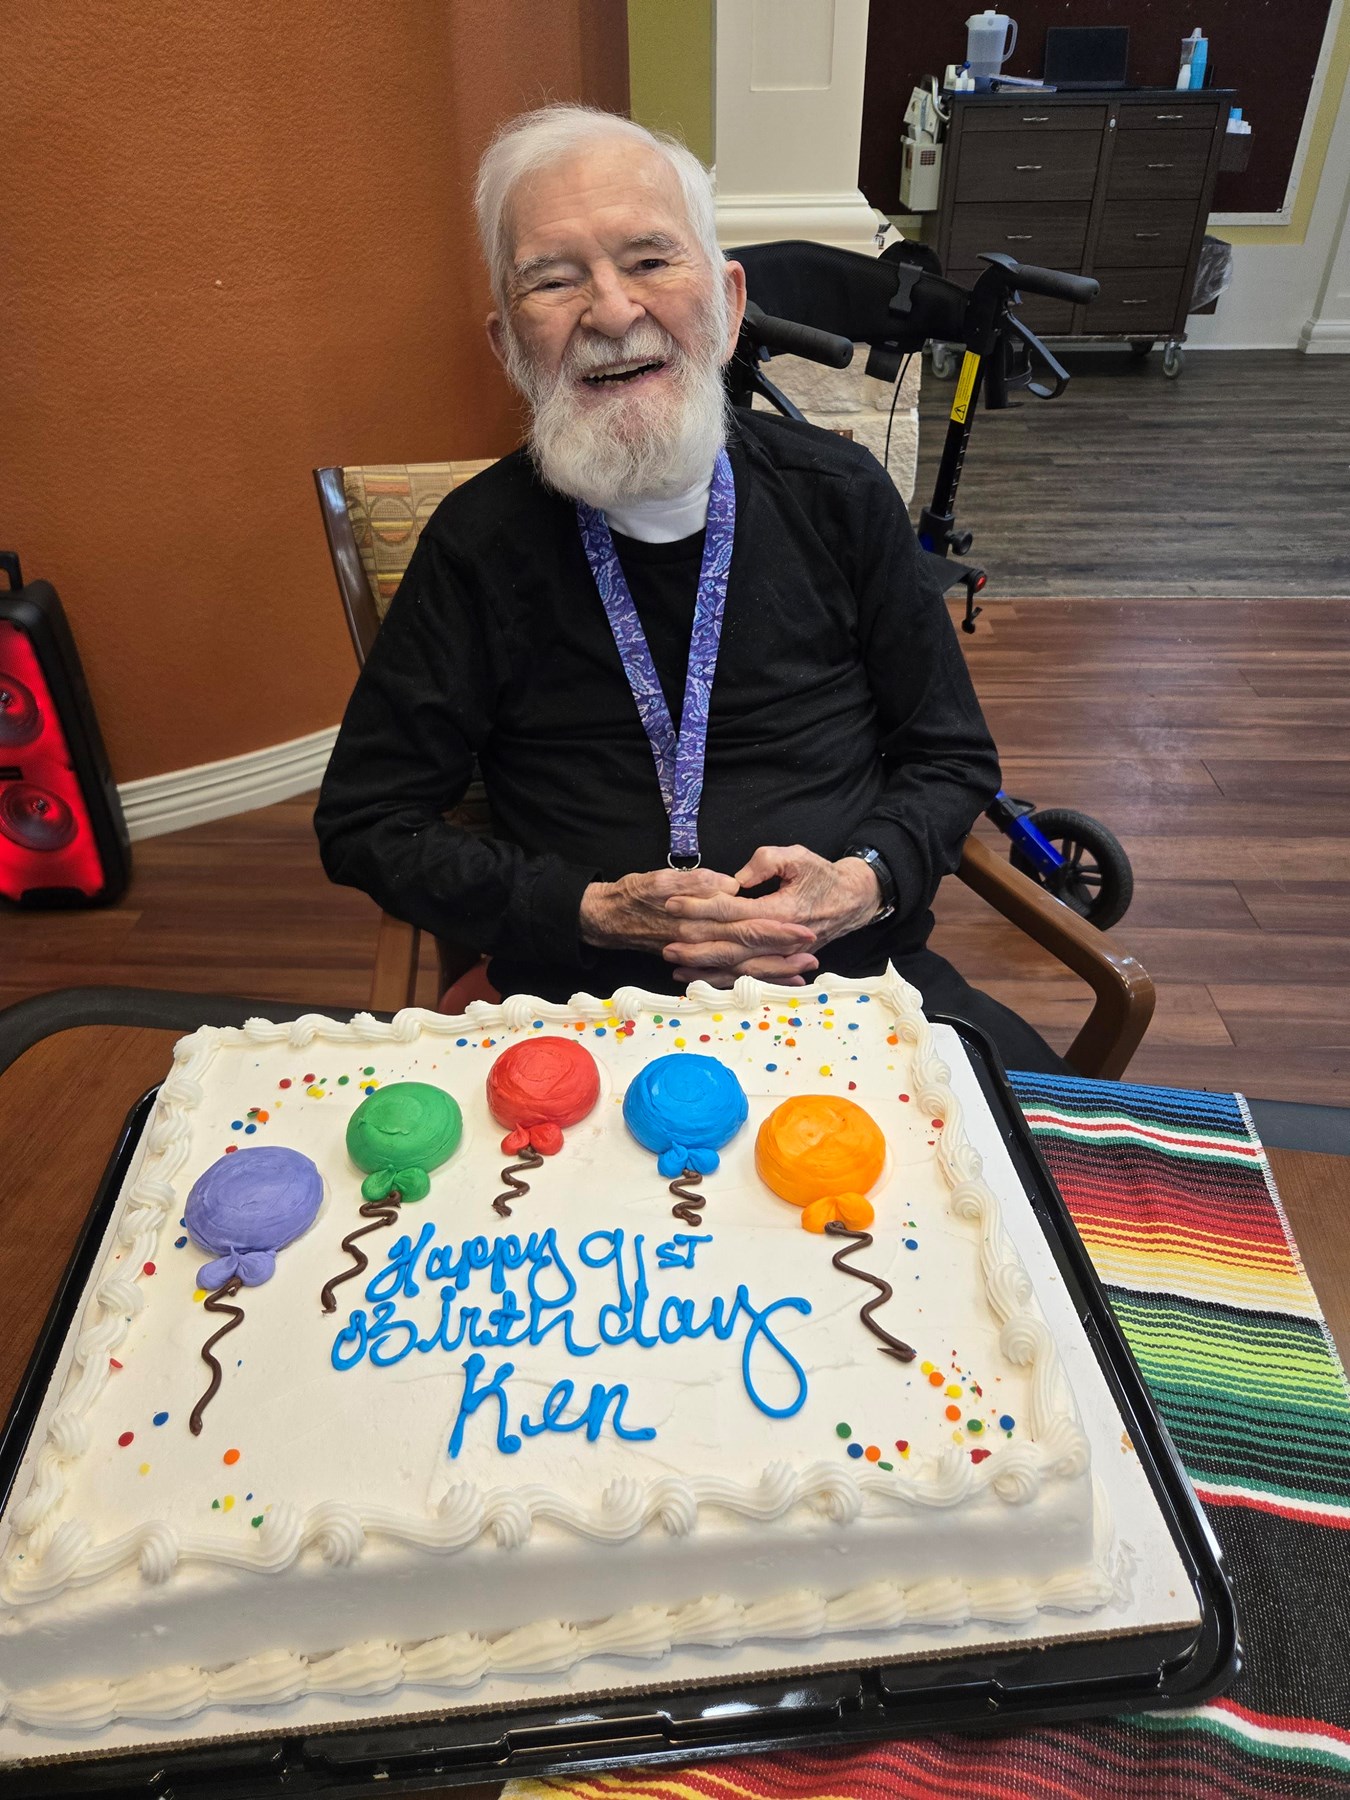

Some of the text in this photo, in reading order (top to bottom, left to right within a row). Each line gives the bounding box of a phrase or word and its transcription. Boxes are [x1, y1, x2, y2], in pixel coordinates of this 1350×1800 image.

[365, 1222, 577, 1307] Happy
[331, 1284, 812, 1419] Birthday
[448, 1353, 657, 1459] Ken
